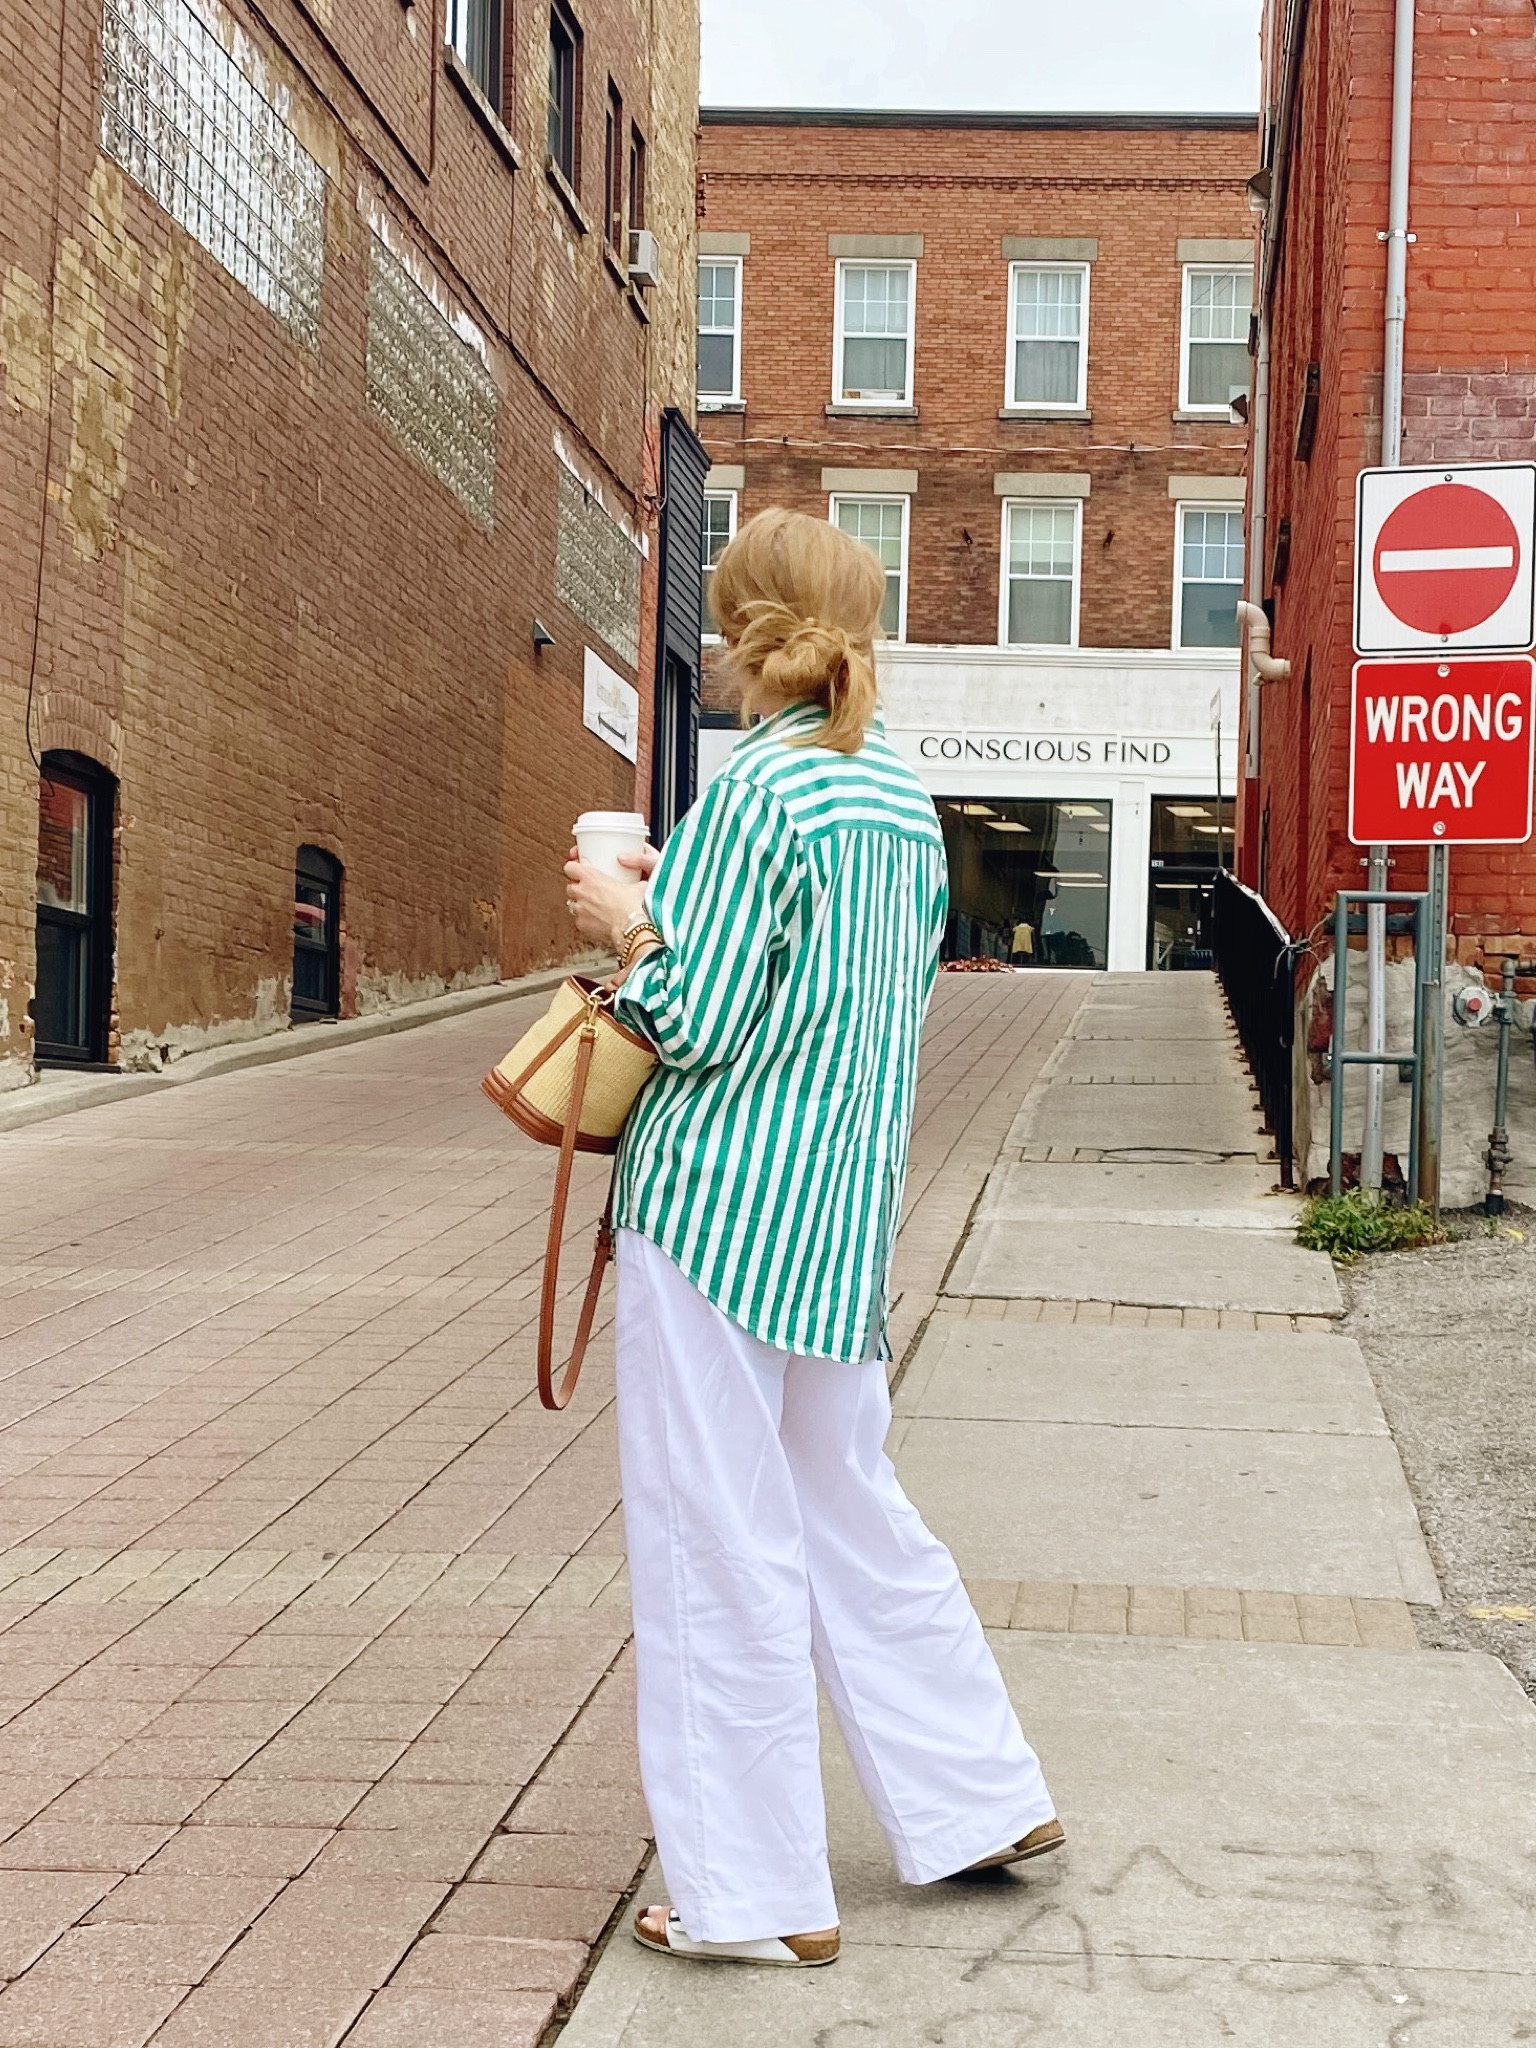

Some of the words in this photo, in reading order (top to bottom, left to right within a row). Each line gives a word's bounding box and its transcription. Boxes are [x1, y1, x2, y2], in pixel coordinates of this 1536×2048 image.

[1365, 692, 1523, 743] WRONG
[920, 736, 1091, 762] CONSCIOUS
[1104, 741, 1171, 763] FIND
[1396, 760, 1486, 809] WAY
